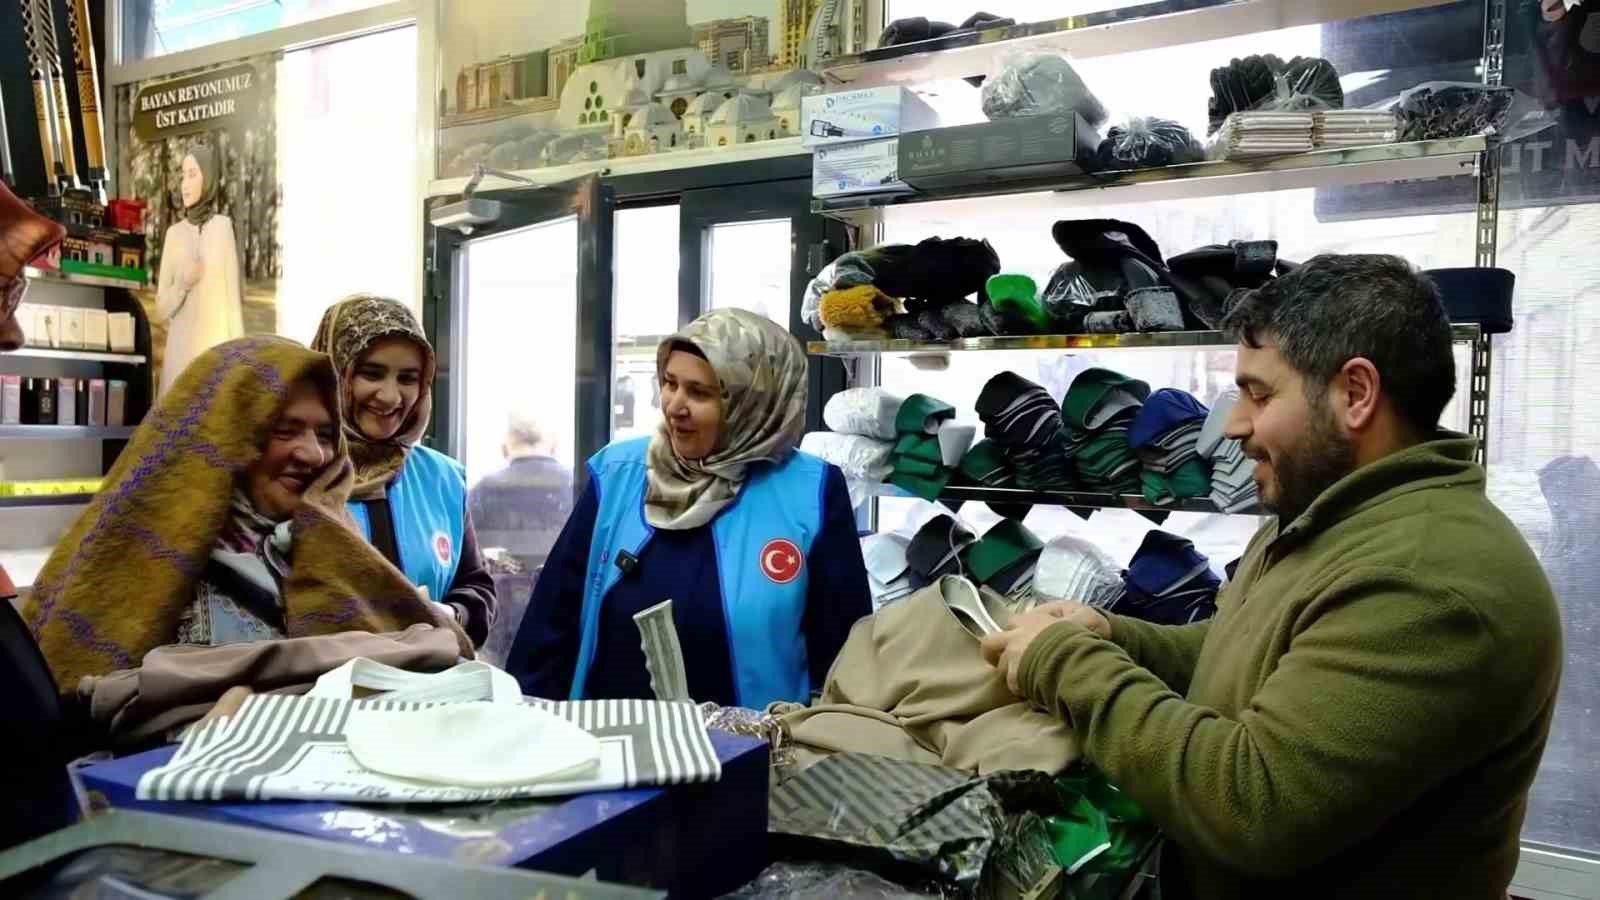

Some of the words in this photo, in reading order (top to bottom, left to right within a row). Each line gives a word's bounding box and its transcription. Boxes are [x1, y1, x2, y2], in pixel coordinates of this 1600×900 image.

[141, 91, 176, 111] BAYAN
[178, 73, 252, 103] REYONUMUZ
[156, 110, 176, 129] ÜST
[178, 99, 236, 124] KATTADIR
